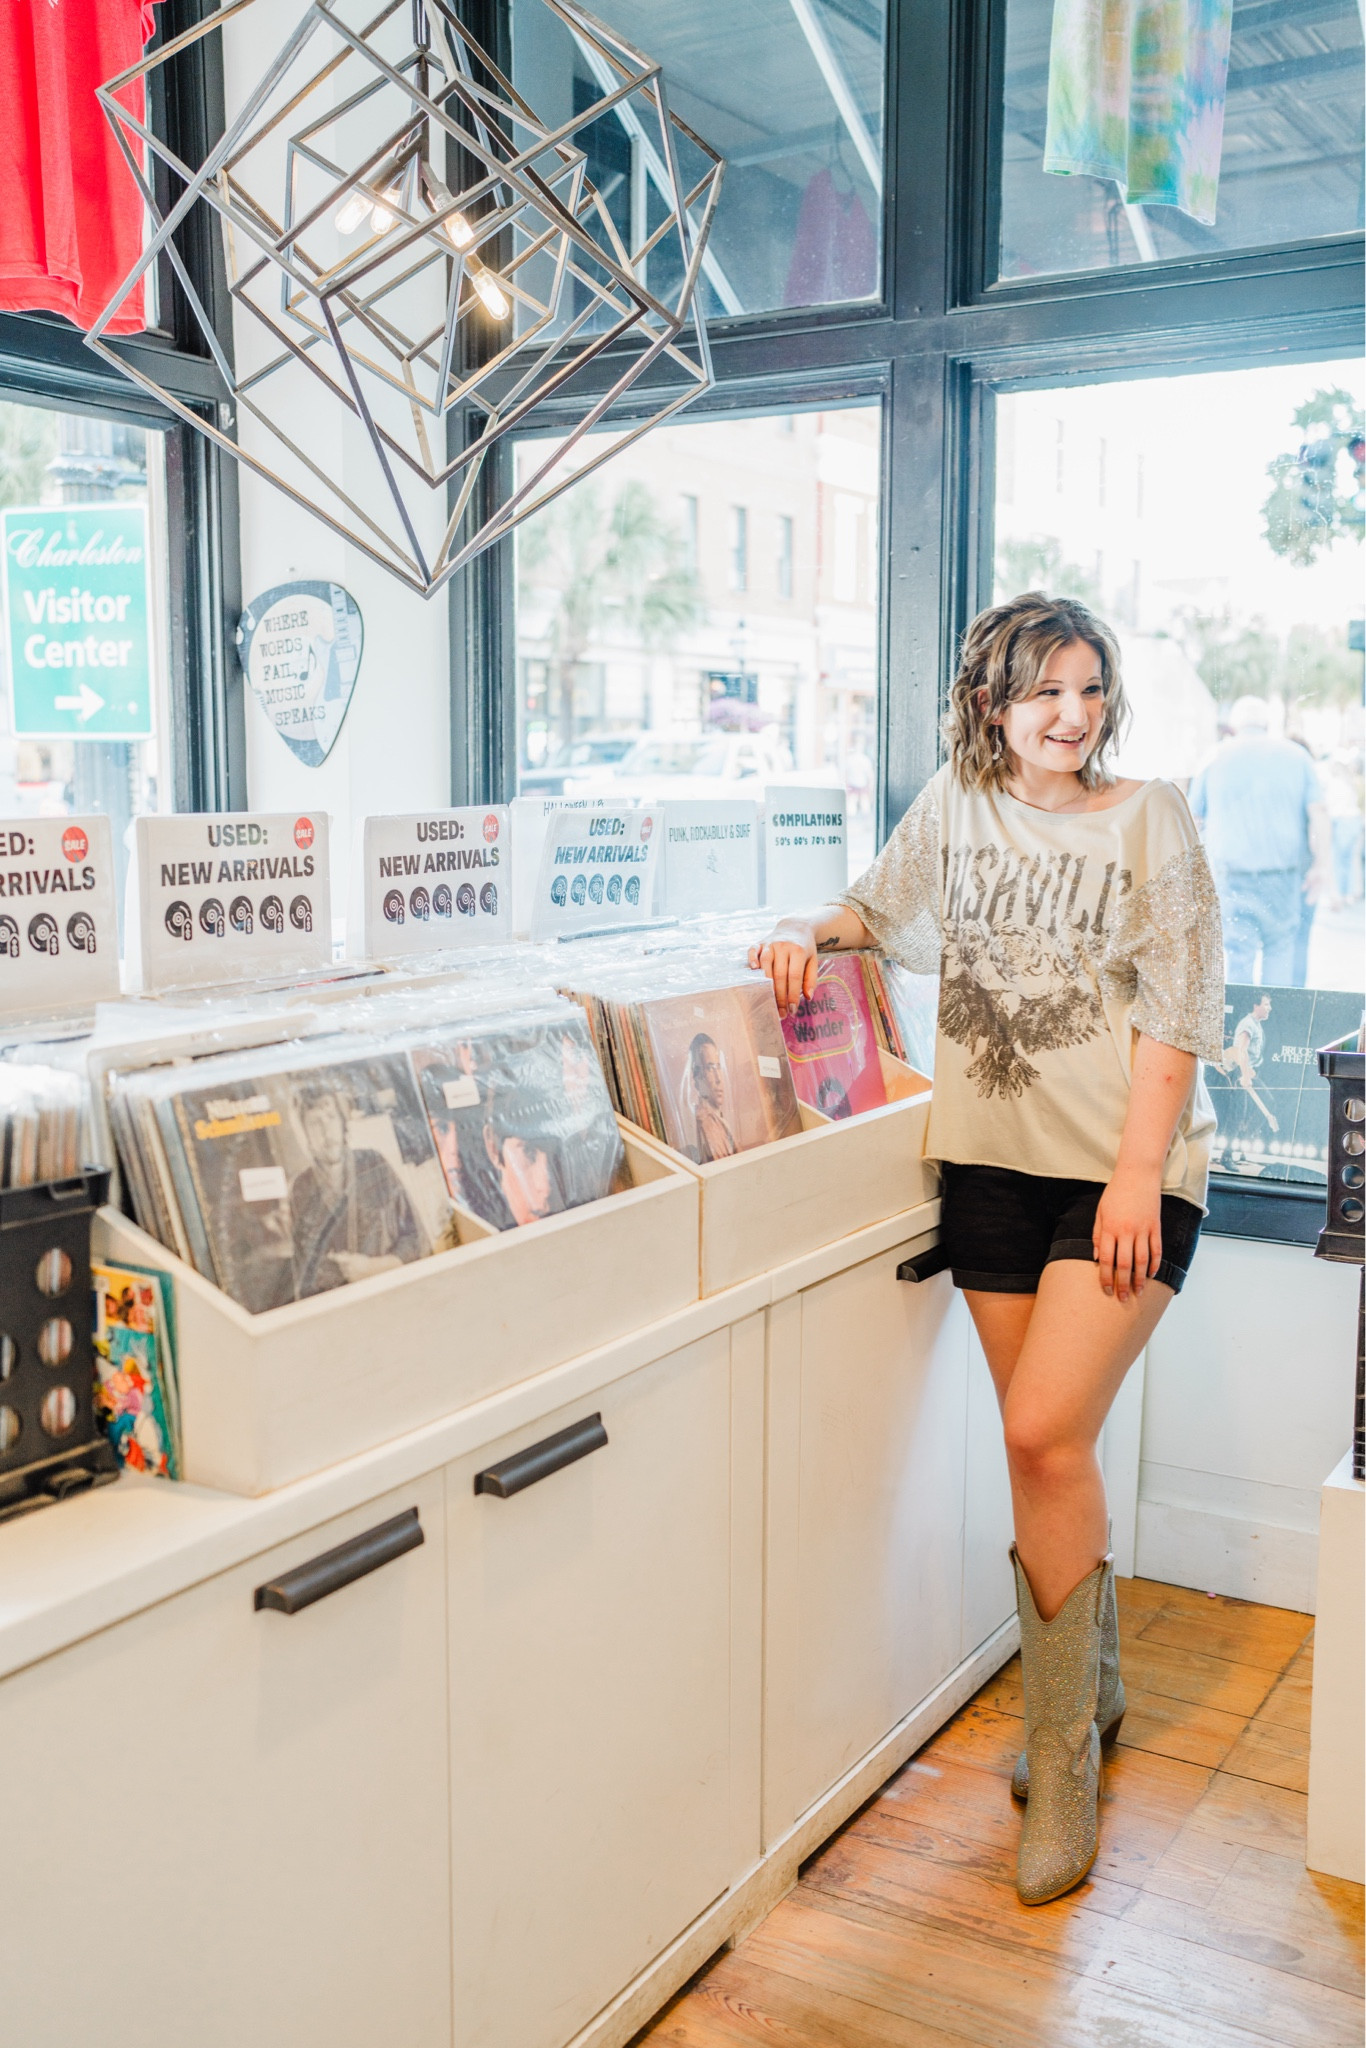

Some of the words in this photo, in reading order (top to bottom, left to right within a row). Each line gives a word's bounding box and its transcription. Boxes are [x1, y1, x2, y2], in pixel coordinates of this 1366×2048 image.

[7, 528, 143, 567] Charleston
[23, 587, 131, 624] Visitor
[264, 611, 309, 633] WHERE
[24, 634, 133, 668] Center
[259, 637, 303, 658] WORDS
[263, 663, 298, 682] FAIL,
[265, 684, 306, 705] MUSIC
[275, 705, 326, 727] SPEAKS
[588, 818, 625, 836] USED:
[772, 813, 843, 827] COMPILATIONS
[208, 824, 268, 847] USED:
[295, 828, 313, 839] SALE
[417, 820, 465, 842] USED:
[669, 827, 690, 843] PUNK,
[690, 825, 729, 841] ROCKABILLY
[729, 824, 735, 838] &
[736, 823, 751, 838] SURF
[775, 837, 791, 847] 50's
[793, 836, 808, 846] 60's
[812, 836, 826, 846] 70's
[828, 835, 842, 846] 80's
[379, 854, 421, 878] NEW
[423, 847, 500, 874] ARRIVALS
[554, 846, 588, 864] NEW
[587, 845, 648, 864] ARRIVALS
[161, 861, 213, 887] NEW
[217, 855, 315, 883] ARRIVALS
[796, 993, 837, 1018] Stevie
[792, 1018, 844, 1043] Wonder
[1271, 1053, 1281, 1062] &
[1282, 1054, 1303, 1064] THE
[1281, 1045, 1313, 1056] BRUCE
